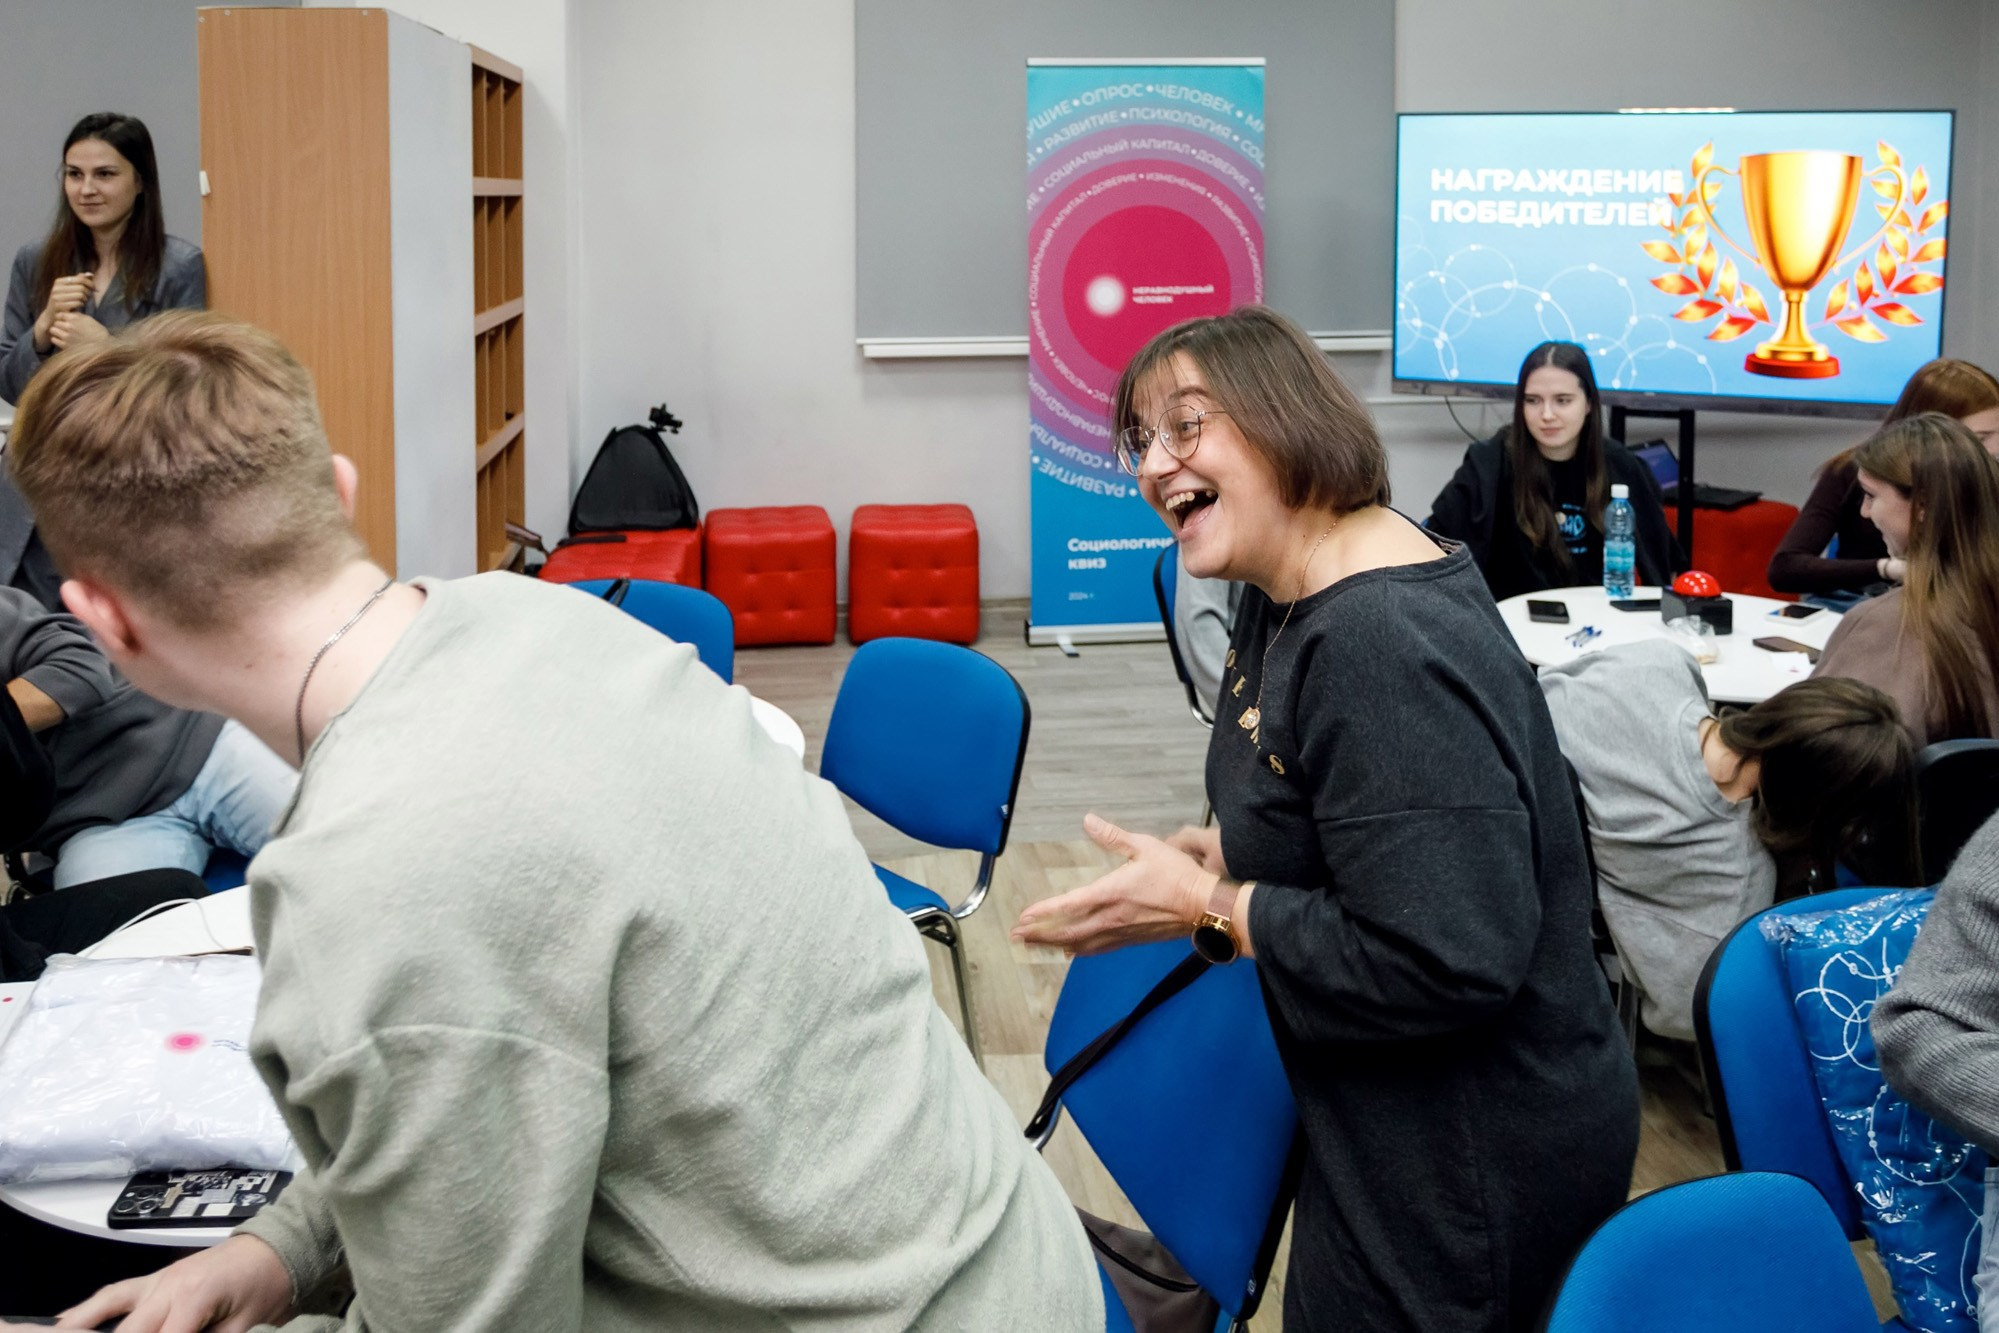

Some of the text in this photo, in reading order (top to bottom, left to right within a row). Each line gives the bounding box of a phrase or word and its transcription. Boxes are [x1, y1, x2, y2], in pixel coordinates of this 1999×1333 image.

[1027, 100, 1073, 140] УШИЕ
[1081, 83, 1144, 106] ОПРОС
[1155, 84, 1236, 115] ЧЕЛОВЕК
[1044, 110, 1119, 150] РАЗВИТИЕ
[1129, 107, 1232, 139] ПСИХОЛОГИЯ
[1044, 138, 1129, 188] СОЦИАЛЬНЫЙ
[1130, 138, 1191, 155] КАПИТАЛ
[1195, 149, 1250, 189] ДОВЕРИЕ
[1430, 167, 1684, 197] НАГРАЖДЕНИЕ
[1430, 197, 1673, 229] ПОБЕДИТЕЛЕЙ
[1038, 457, 1126, 498] РАЗВИТИЕ
[1067, 557, 1107, 570] квиз
